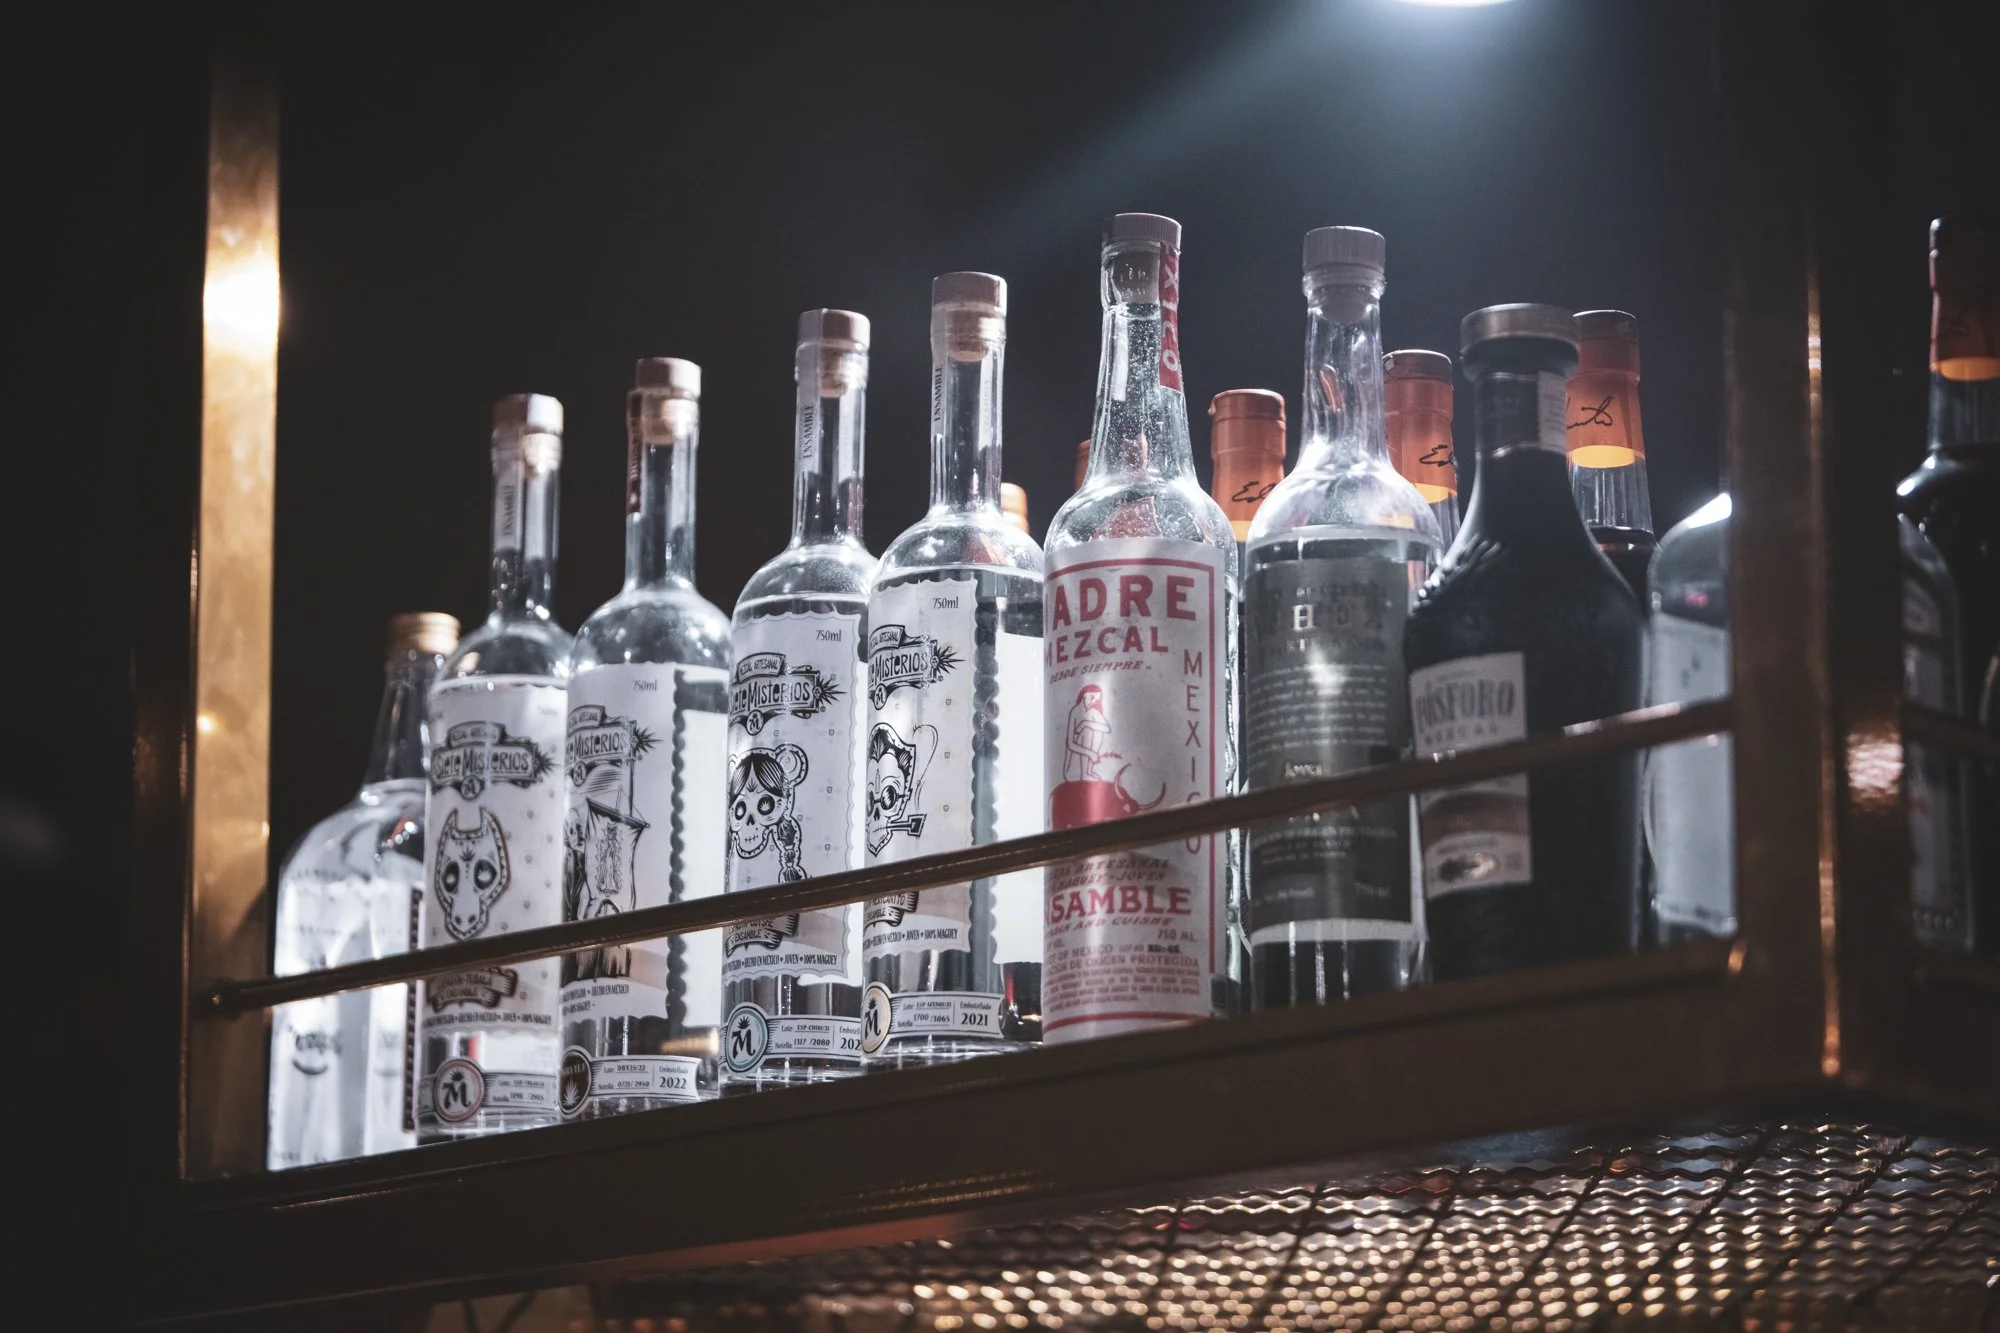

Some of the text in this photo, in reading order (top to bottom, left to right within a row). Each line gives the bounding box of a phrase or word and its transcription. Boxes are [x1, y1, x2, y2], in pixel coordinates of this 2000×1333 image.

[932, 596, 959, 609] 750ml
[815, 629, 842, 642] 750ml
[1079, 660, 1144, 675] SIEMPRE
[632, 679, 657, 691] 750ml
[937, 928, 958, 939] MAGUEY
[816, 954, 837, 965] MAGUEY
[960, 1001, 992, 1010] Embotellado
[961, 1012, 989, 1026] 2021
[781, 1025, 793, 1033] Lote
[840, 1037, 861, 1051] 202
[659, 1076, 687, 1090] 2022
